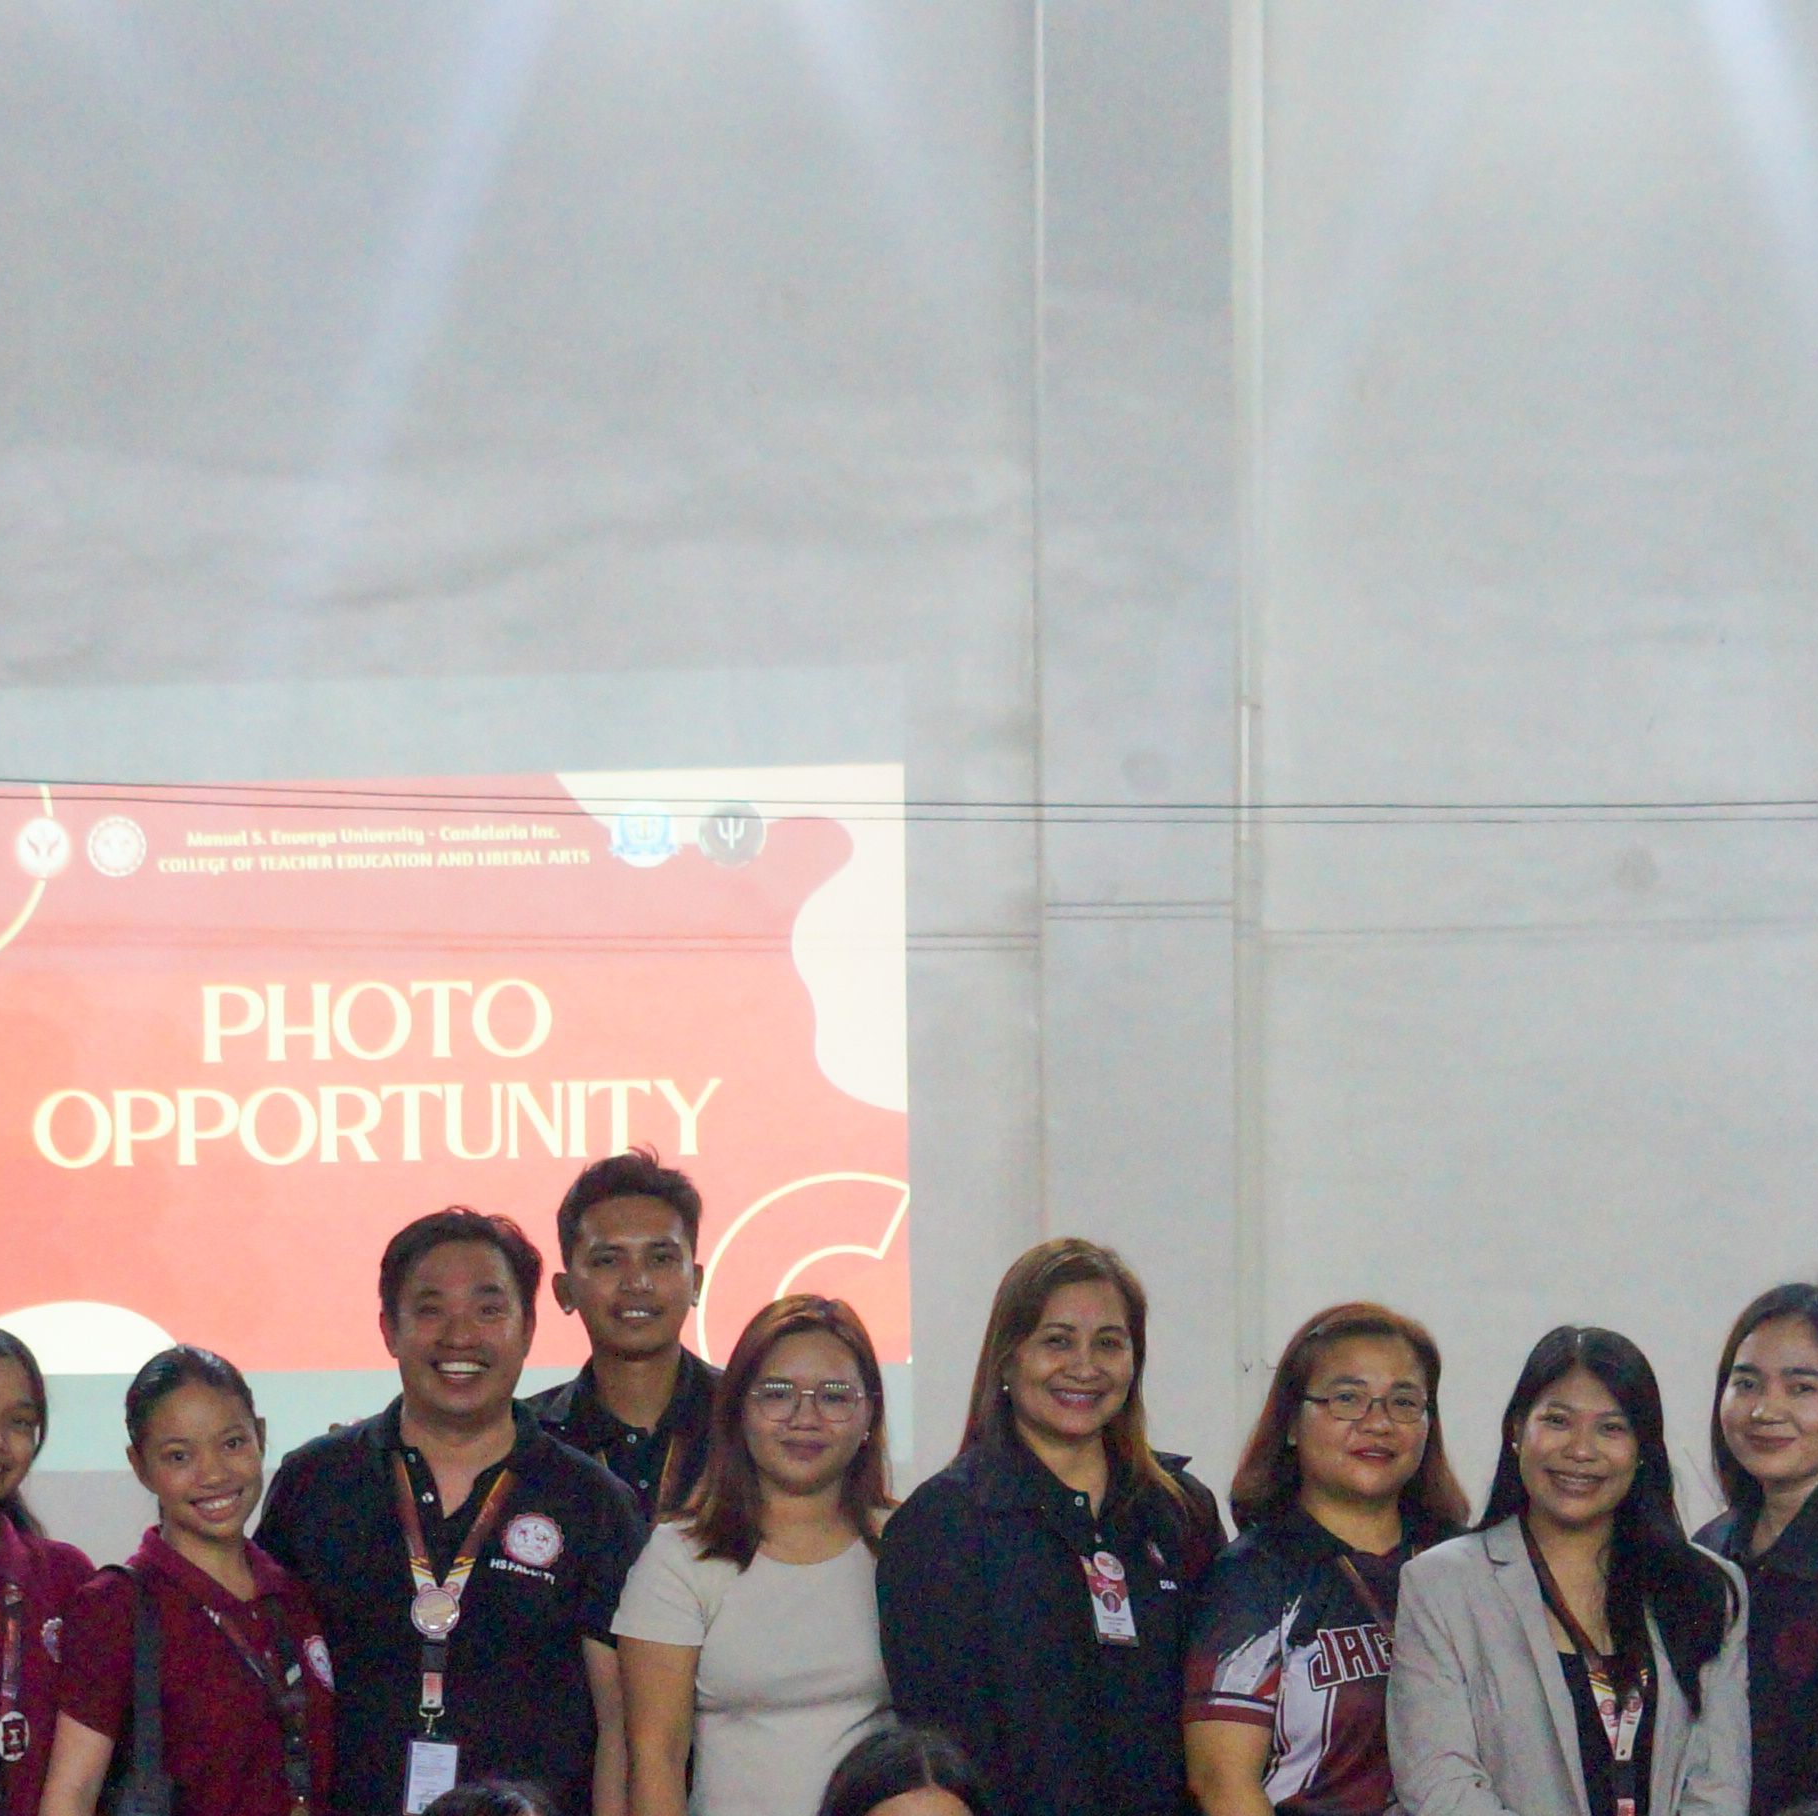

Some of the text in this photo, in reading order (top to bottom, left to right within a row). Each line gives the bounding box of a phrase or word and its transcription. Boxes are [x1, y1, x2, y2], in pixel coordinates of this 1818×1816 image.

[157, 849, 591, 875] COLLEGE OF TEACHER EDUCATION AND LIBERAL ARTS
[186, 831, 248, 848] Manuel
[251, 831, 268, 847] S.
[271, 829, 338, 849] Enverga
[340, 827, 425, 847] University
[439, 825, 530, 843] Candelaria
[531, 825, 562, 840] Inc.
[200, 977, 554, 1064] PHOTO
[31, 1077, 723, 1170] OPPORTUNITY
